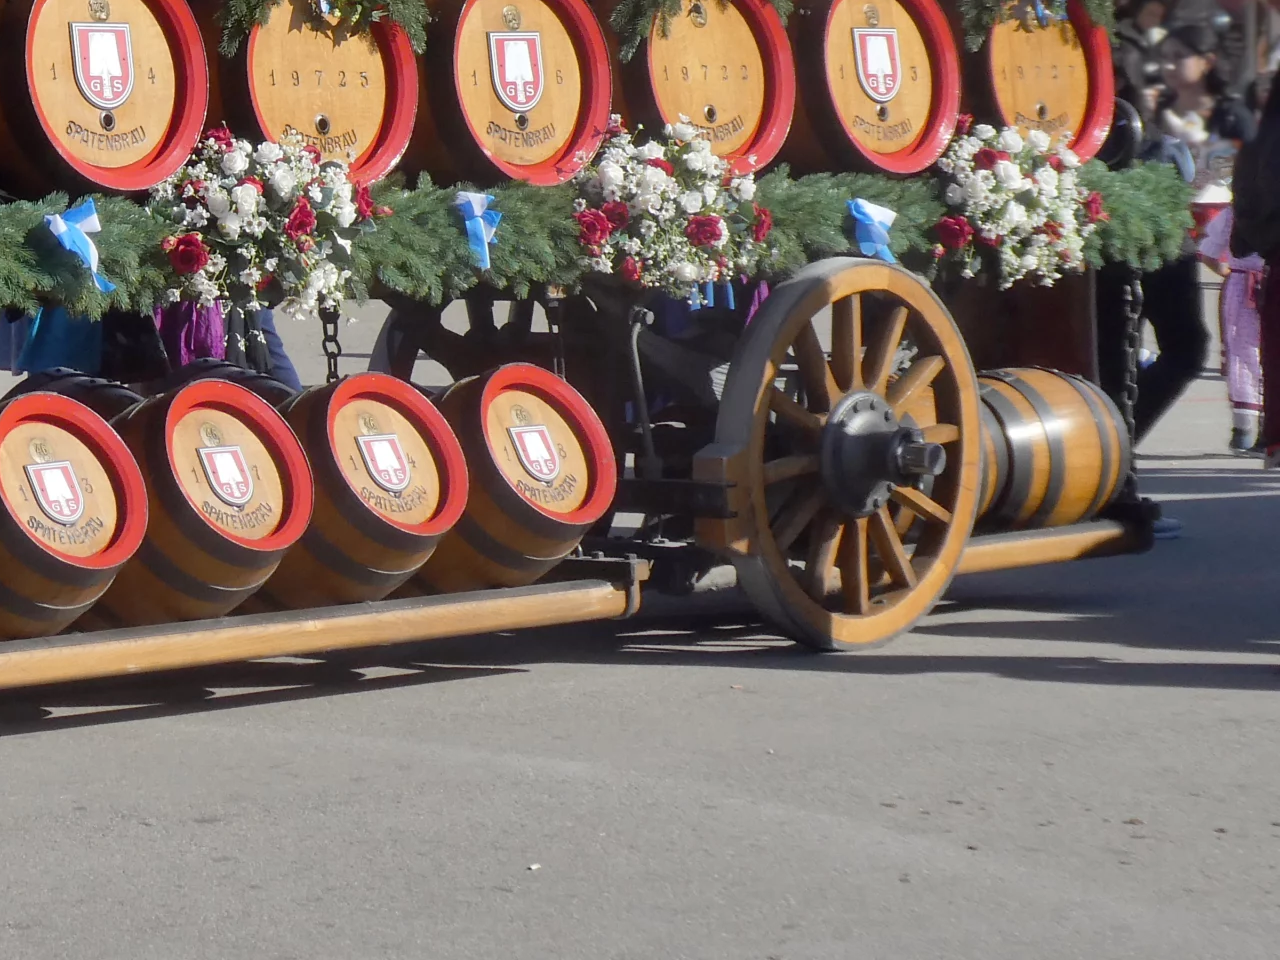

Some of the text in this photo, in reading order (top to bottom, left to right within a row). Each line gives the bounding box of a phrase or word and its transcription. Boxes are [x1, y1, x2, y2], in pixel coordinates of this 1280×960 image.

[50, 62, 156, 85] 1 4
[556, 69, 564, 85] 6
[90, 79, 123, 92] G S
[868, 76, 894, 88] G S
[506, 85, 535, 96] G S
[66, 120, 147, 152] SPATENBRÄU
[486, 120, 556, 148] SPATENBRÄU
[533, 460, 554, 471] G S
[381, 470, 404, 480] G S
[81, 477, 94, 494] 3
[223, 483, 247, 494] G S
[51, 499, 77, 512] G S
